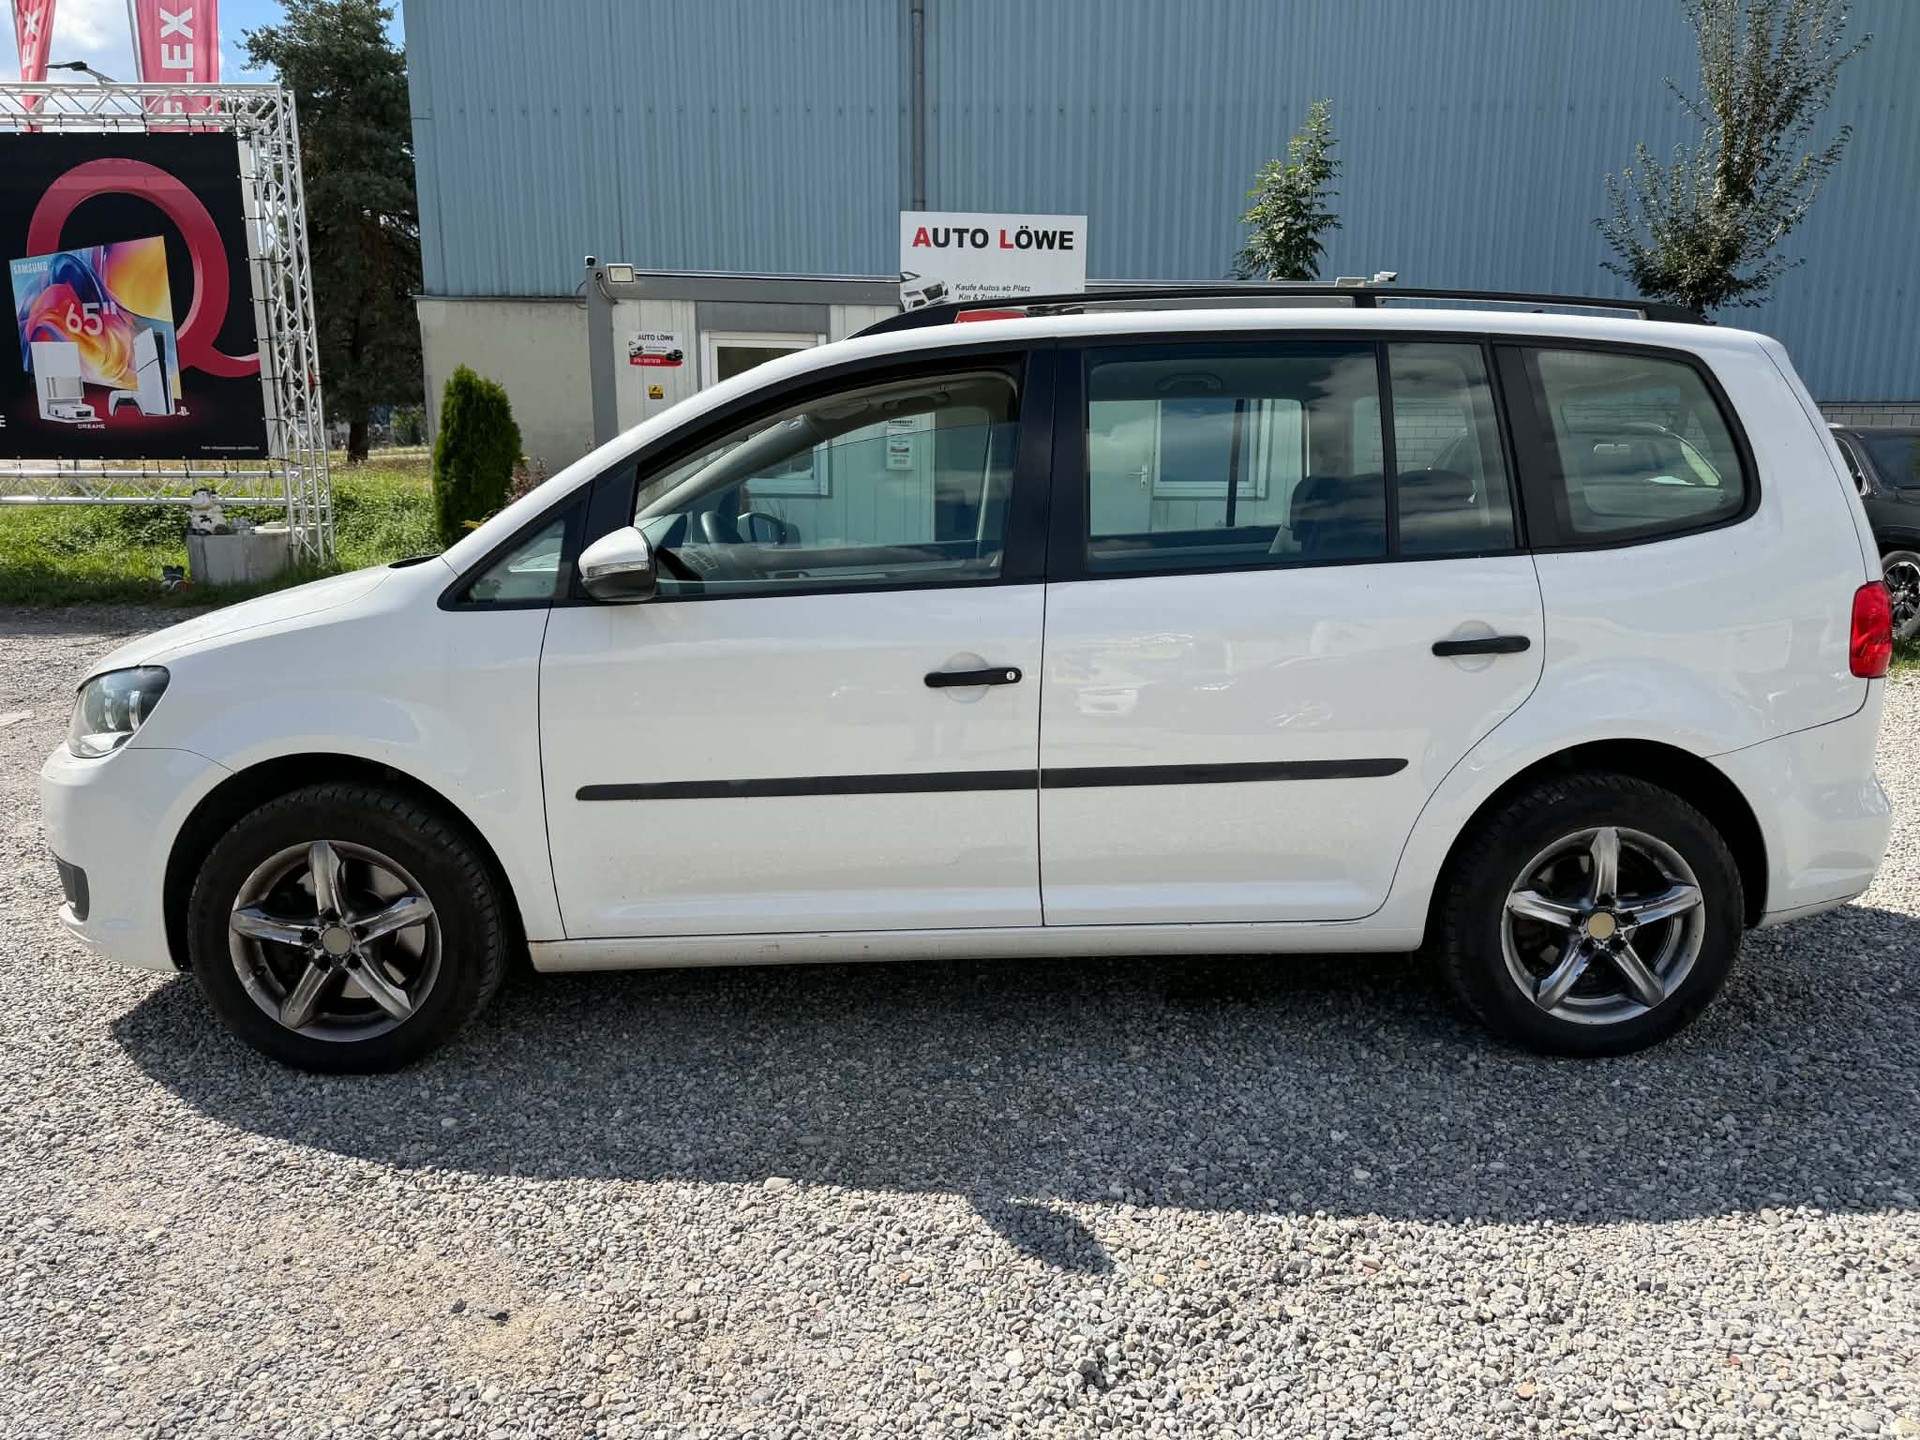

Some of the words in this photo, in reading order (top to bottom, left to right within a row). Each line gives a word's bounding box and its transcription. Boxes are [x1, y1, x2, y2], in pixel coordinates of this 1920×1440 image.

[912, 226, 990, 249] AUTO
[1000, 225, 1075, 250] LÖWE
[13, 260, 48, 275] SAMSUNG
[955, 283, 977, 291] Kaufe
[978, 284, 1000, 292] Autos
[1002, 284, 1011, 292] ab
[1012, 284, 1031, 292] Platz
